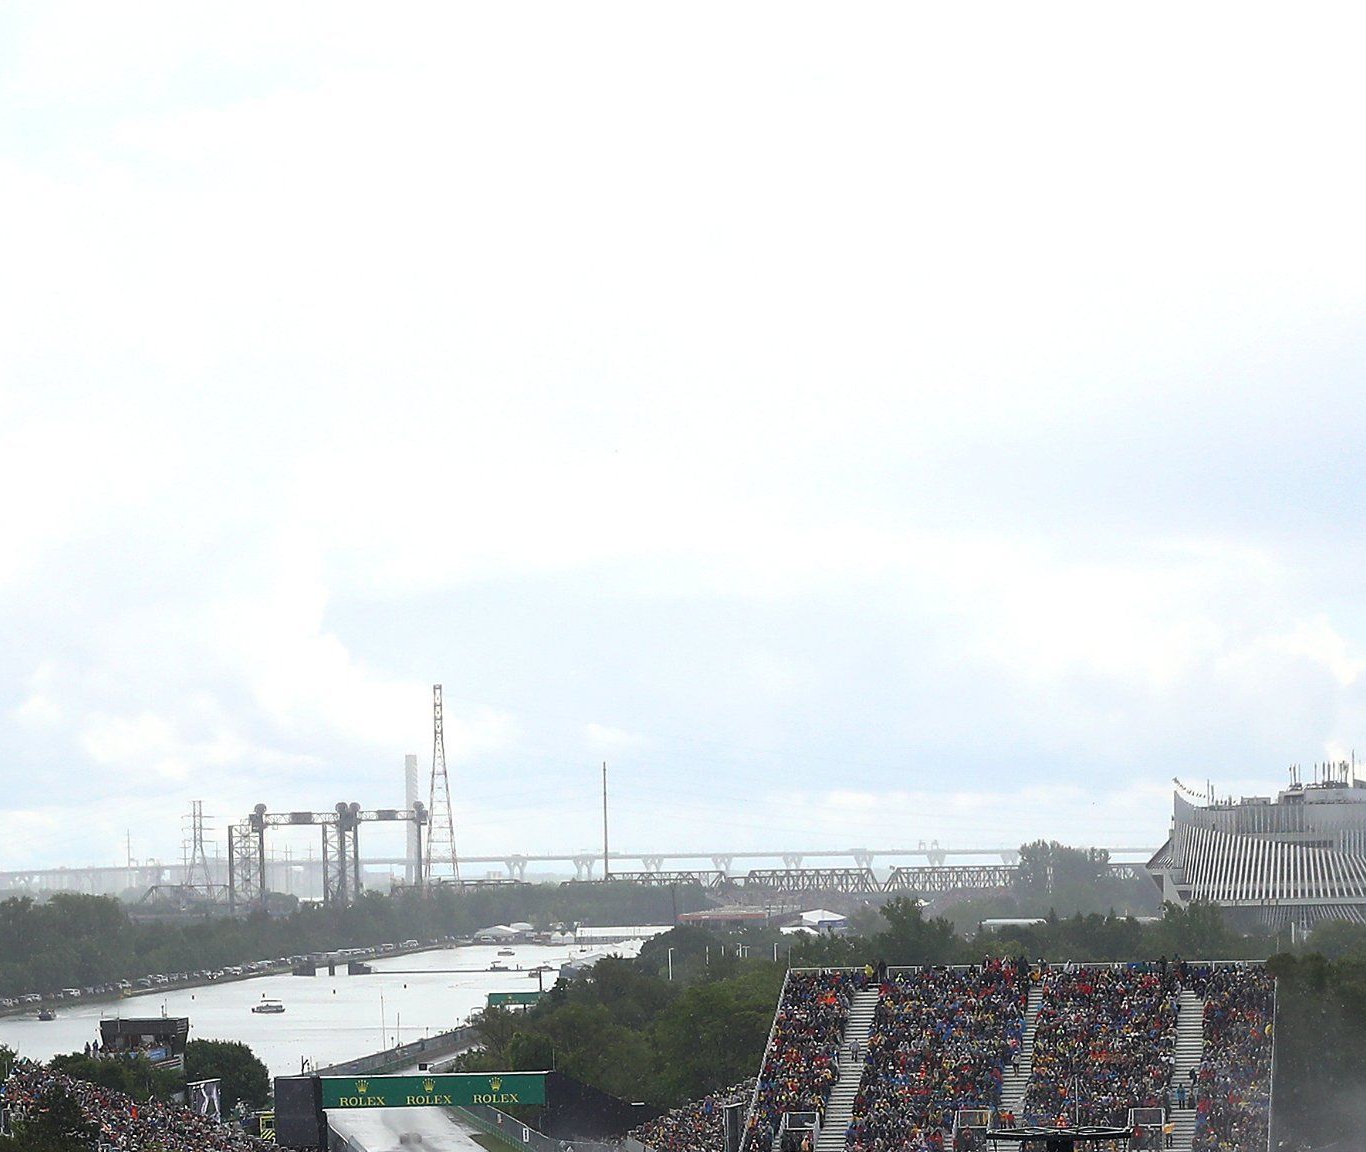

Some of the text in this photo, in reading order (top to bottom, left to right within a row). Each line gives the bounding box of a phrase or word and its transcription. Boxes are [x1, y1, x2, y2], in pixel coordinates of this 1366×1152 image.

[339, 1096, 385, 1107] ROLEX
[406, 1095, 452, 1105] ROLEX
[473, 1093, 519, 1104] ROLEX
